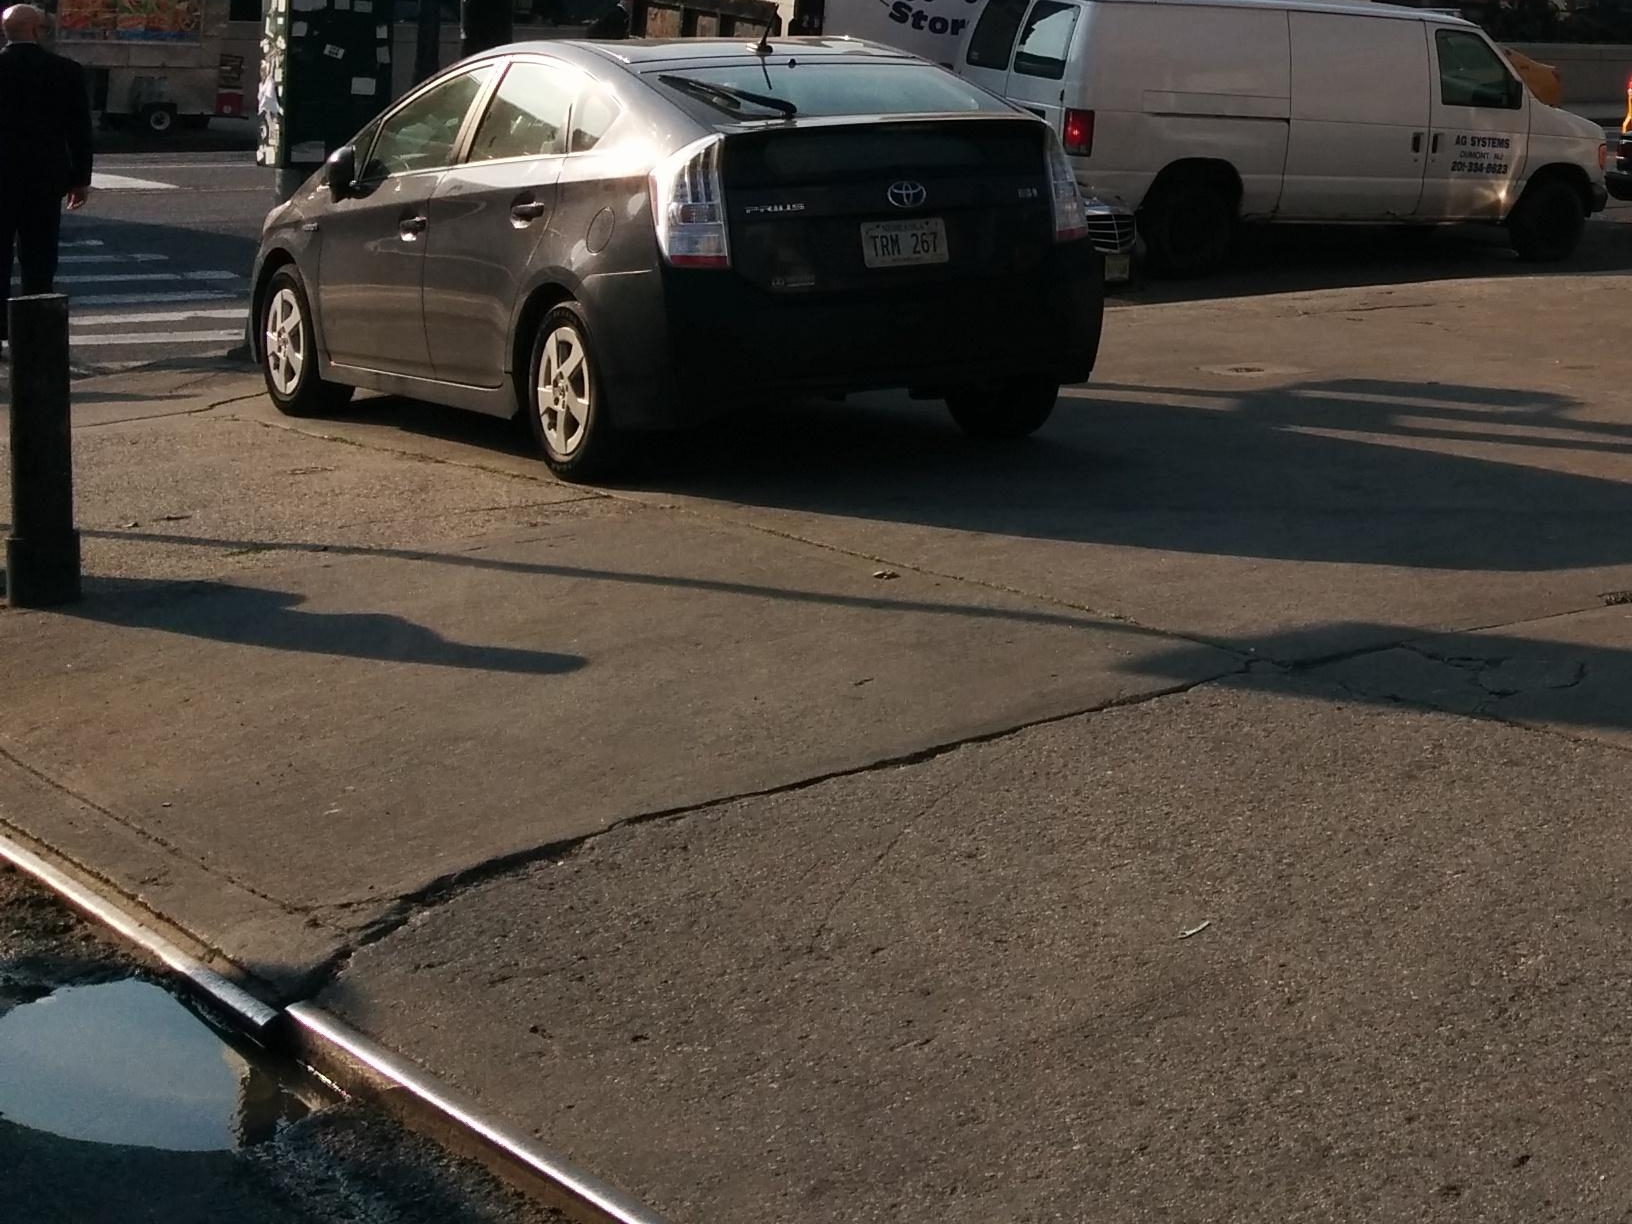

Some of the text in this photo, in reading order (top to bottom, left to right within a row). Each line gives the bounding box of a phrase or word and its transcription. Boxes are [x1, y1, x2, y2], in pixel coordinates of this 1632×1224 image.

[889, 0, 968, 36] Stor
[1456, 135, 1510, 149] AG SYSTEMS
[745, 203, 806, 214] PRIUS
[870, 232, 938, 256] TRM 267
